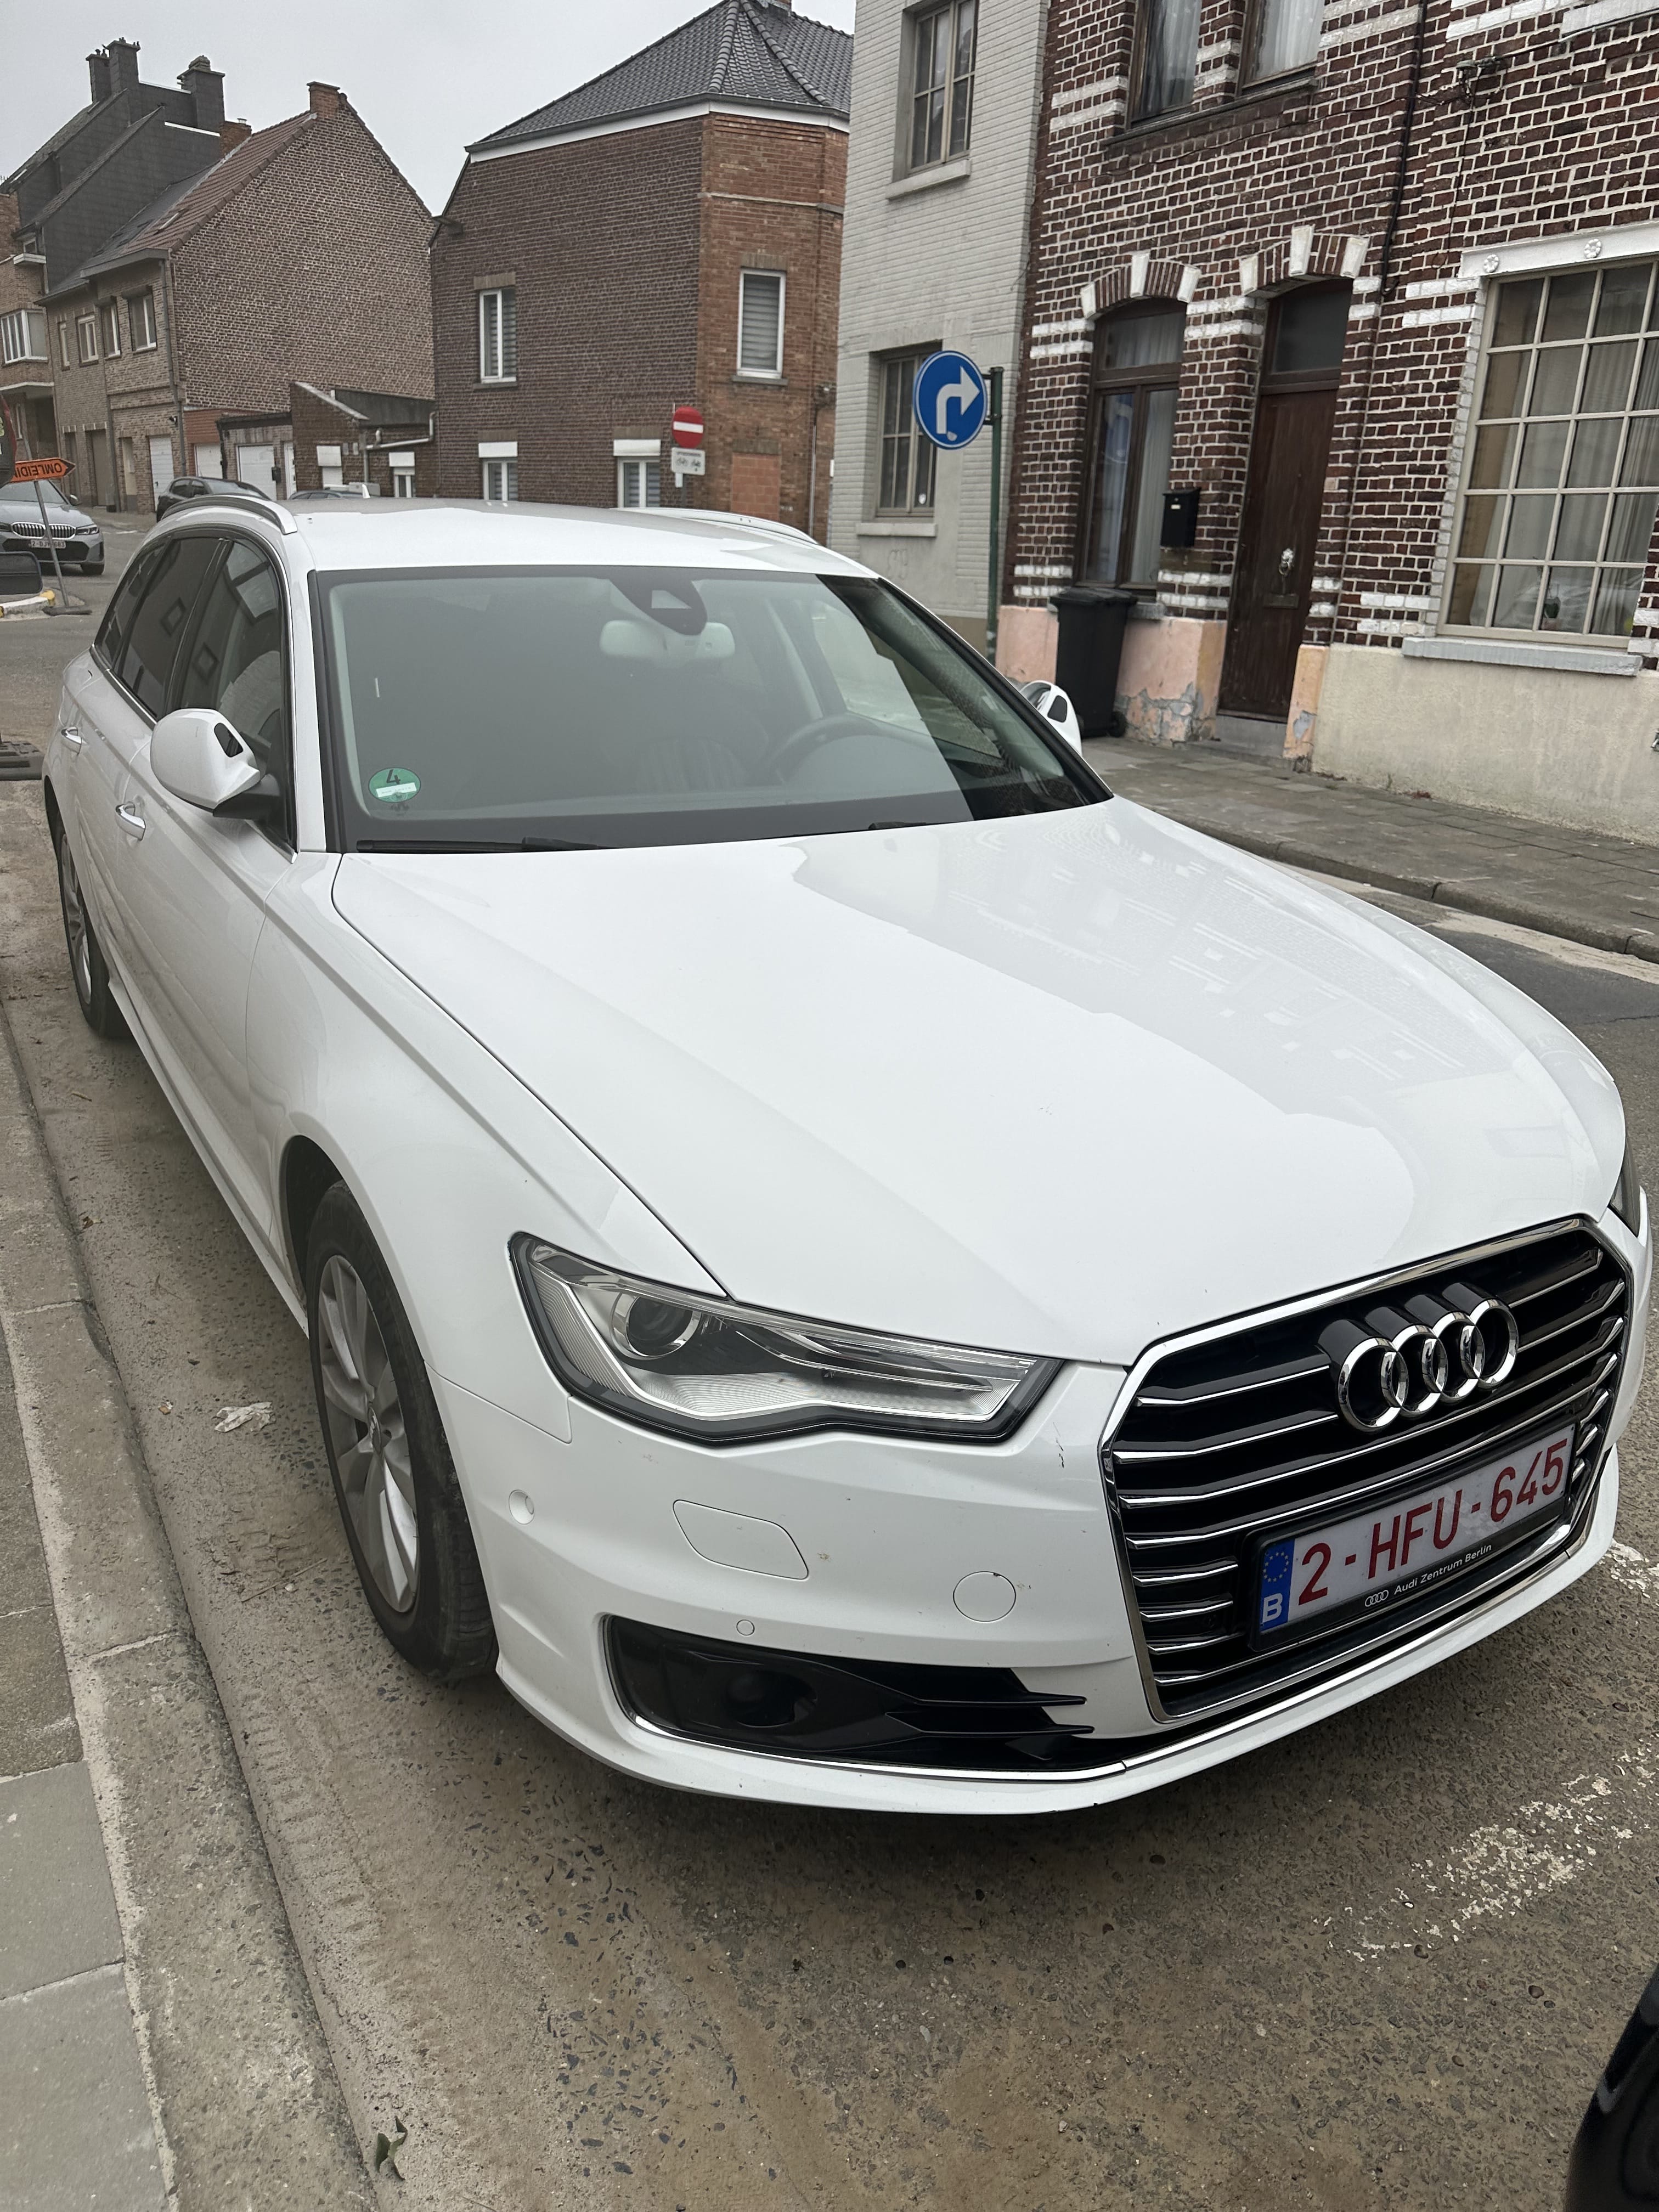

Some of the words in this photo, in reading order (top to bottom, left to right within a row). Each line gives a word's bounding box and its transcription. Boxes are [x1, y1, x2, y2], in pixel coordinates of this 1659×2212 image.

[15, 462, 63, 478] OMLEIDI
[386, 769, 401, 785] 4
[1299, 1438, 1567, 1605] 2-HFU-645
[1394, 1578, 1417, 1595] Audi
[1420, 1559, 1463, 1584] Zentrum
[1465, 1544, 1492, 1562] Berlin
[1262, 1593, 1283, 1623] B
